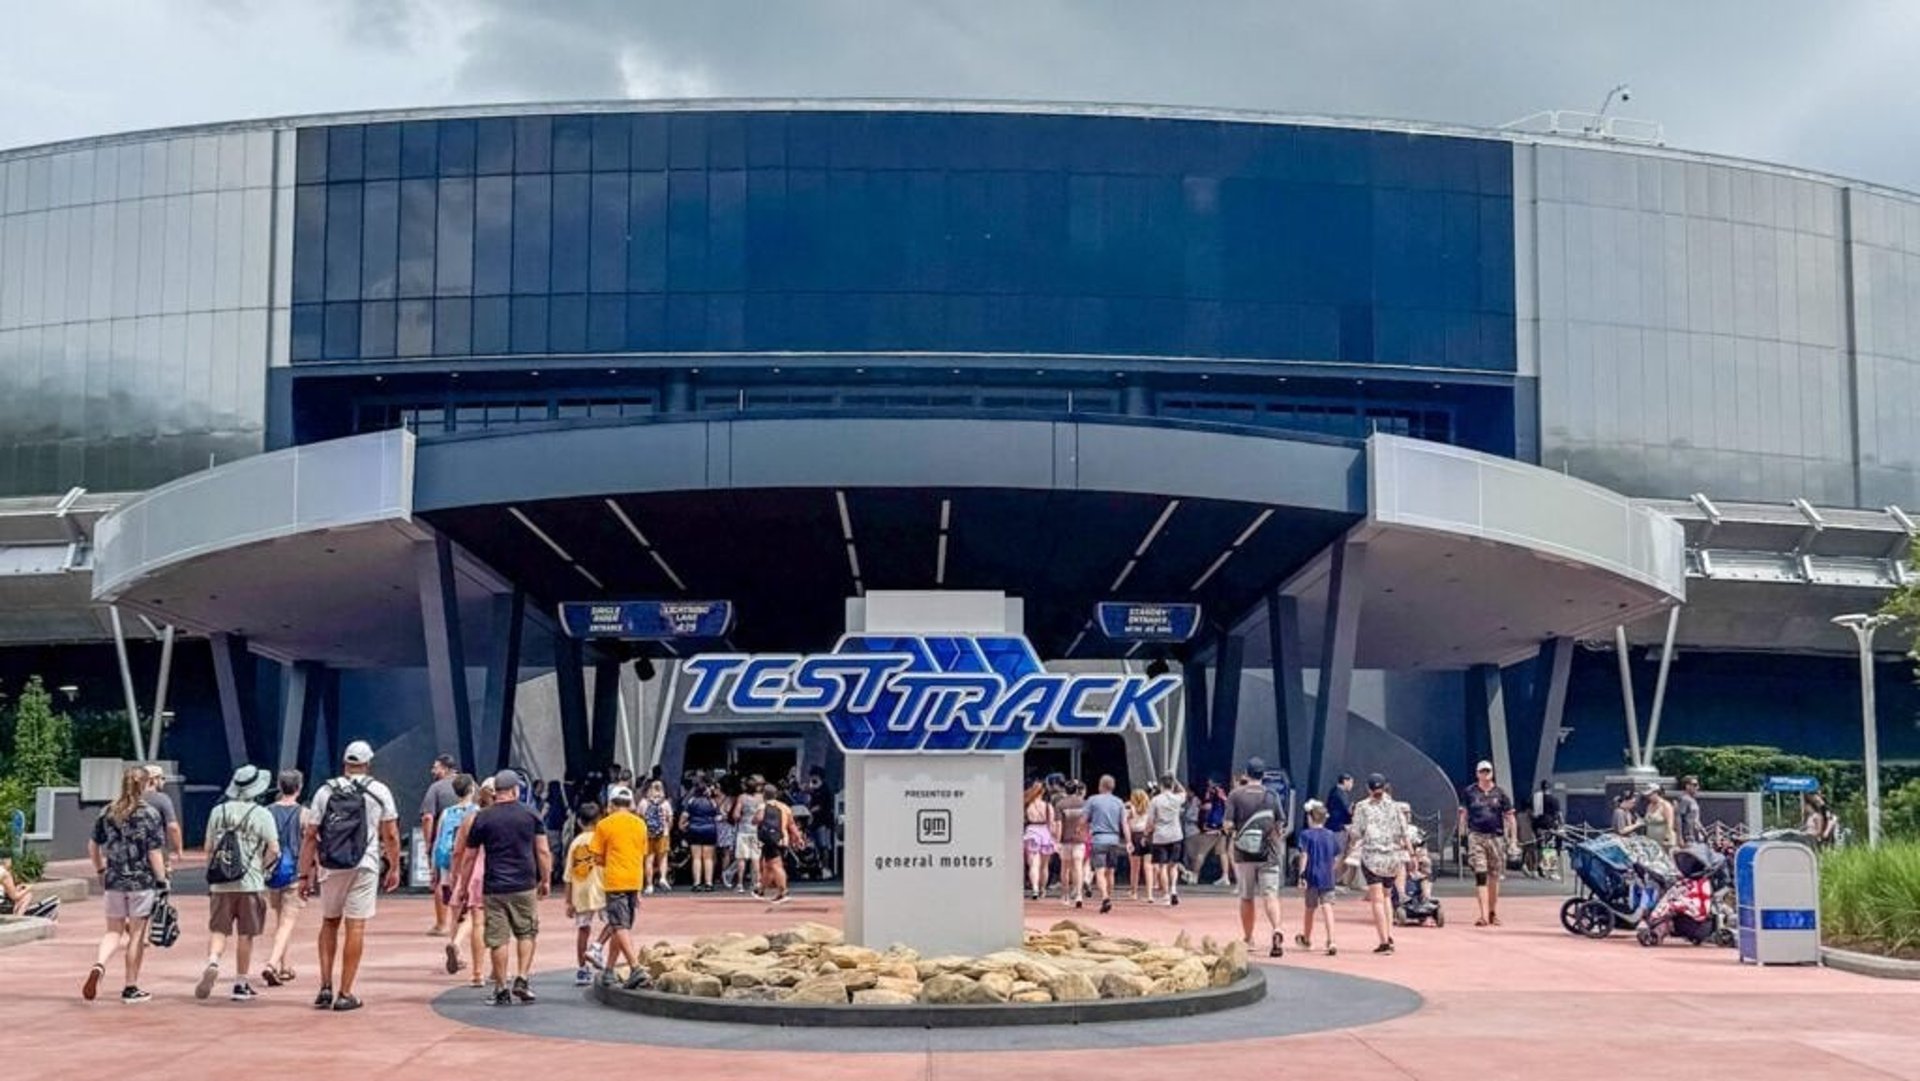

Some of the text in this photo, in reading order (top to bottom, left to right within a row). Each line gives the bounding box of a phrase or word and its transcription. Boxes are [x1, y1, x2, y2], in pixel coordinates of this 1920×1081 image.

[683, 653, 1184, 733] TEST TRACK
[904, 790, 965, 798] PRESENTED BY
[923, 818, 945, 836] gm
[875, 854, 993, 870] general motors
